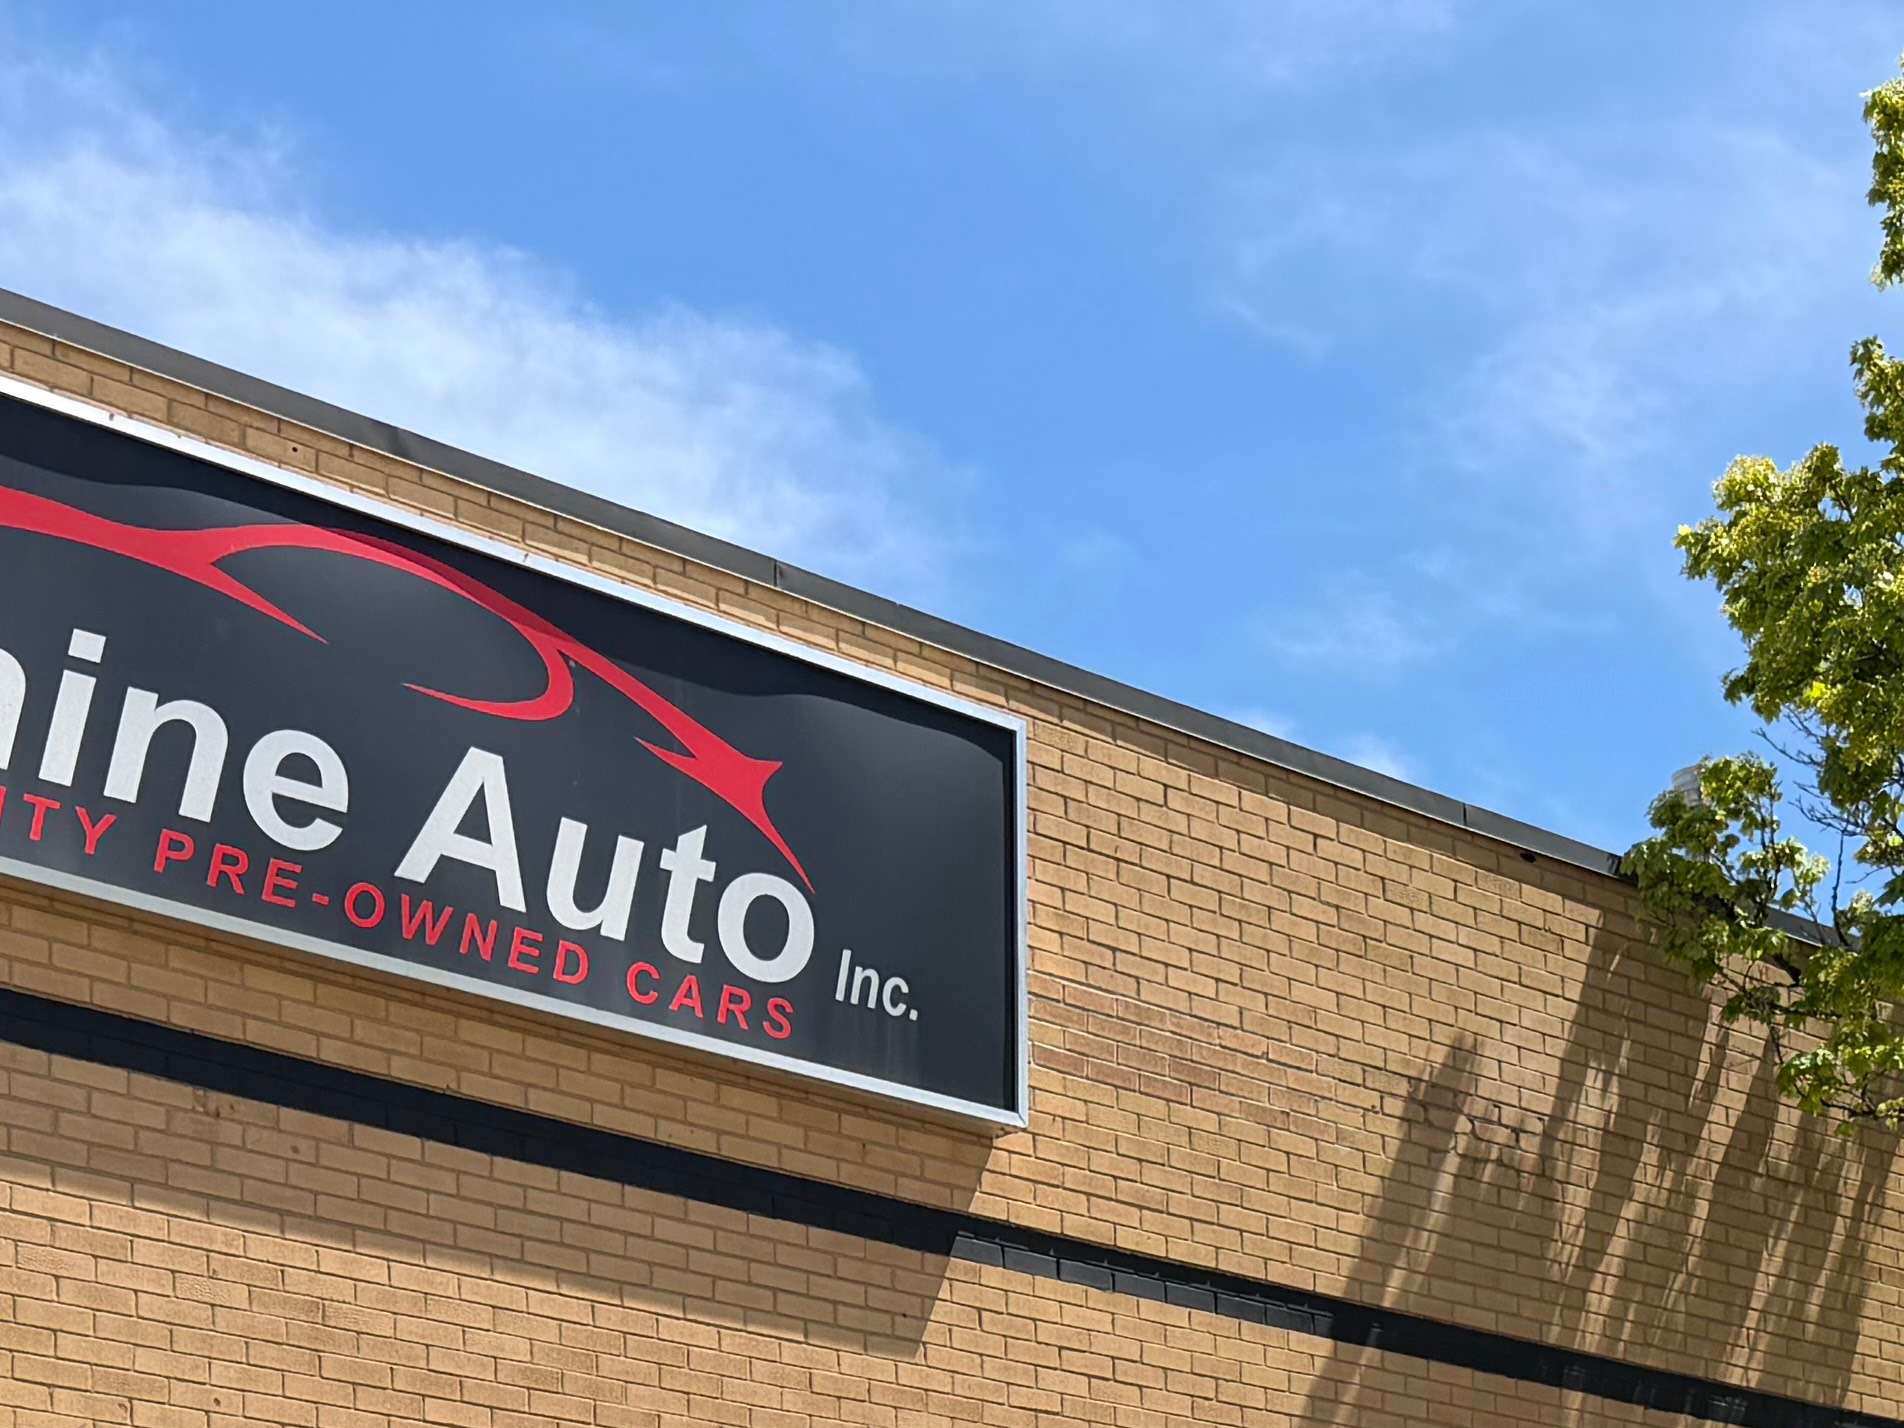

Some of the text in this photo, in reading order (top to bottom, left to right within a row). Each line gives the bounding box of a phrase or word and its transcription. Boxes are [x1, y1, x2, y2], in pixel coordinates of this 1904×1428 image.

[154, 830, 590, 985] PRE-OWNED
[626, 961, 796, 1041] CARS
[393, 745, 815, 984] Auto
[835, 949, 919, 1022] Inc.
